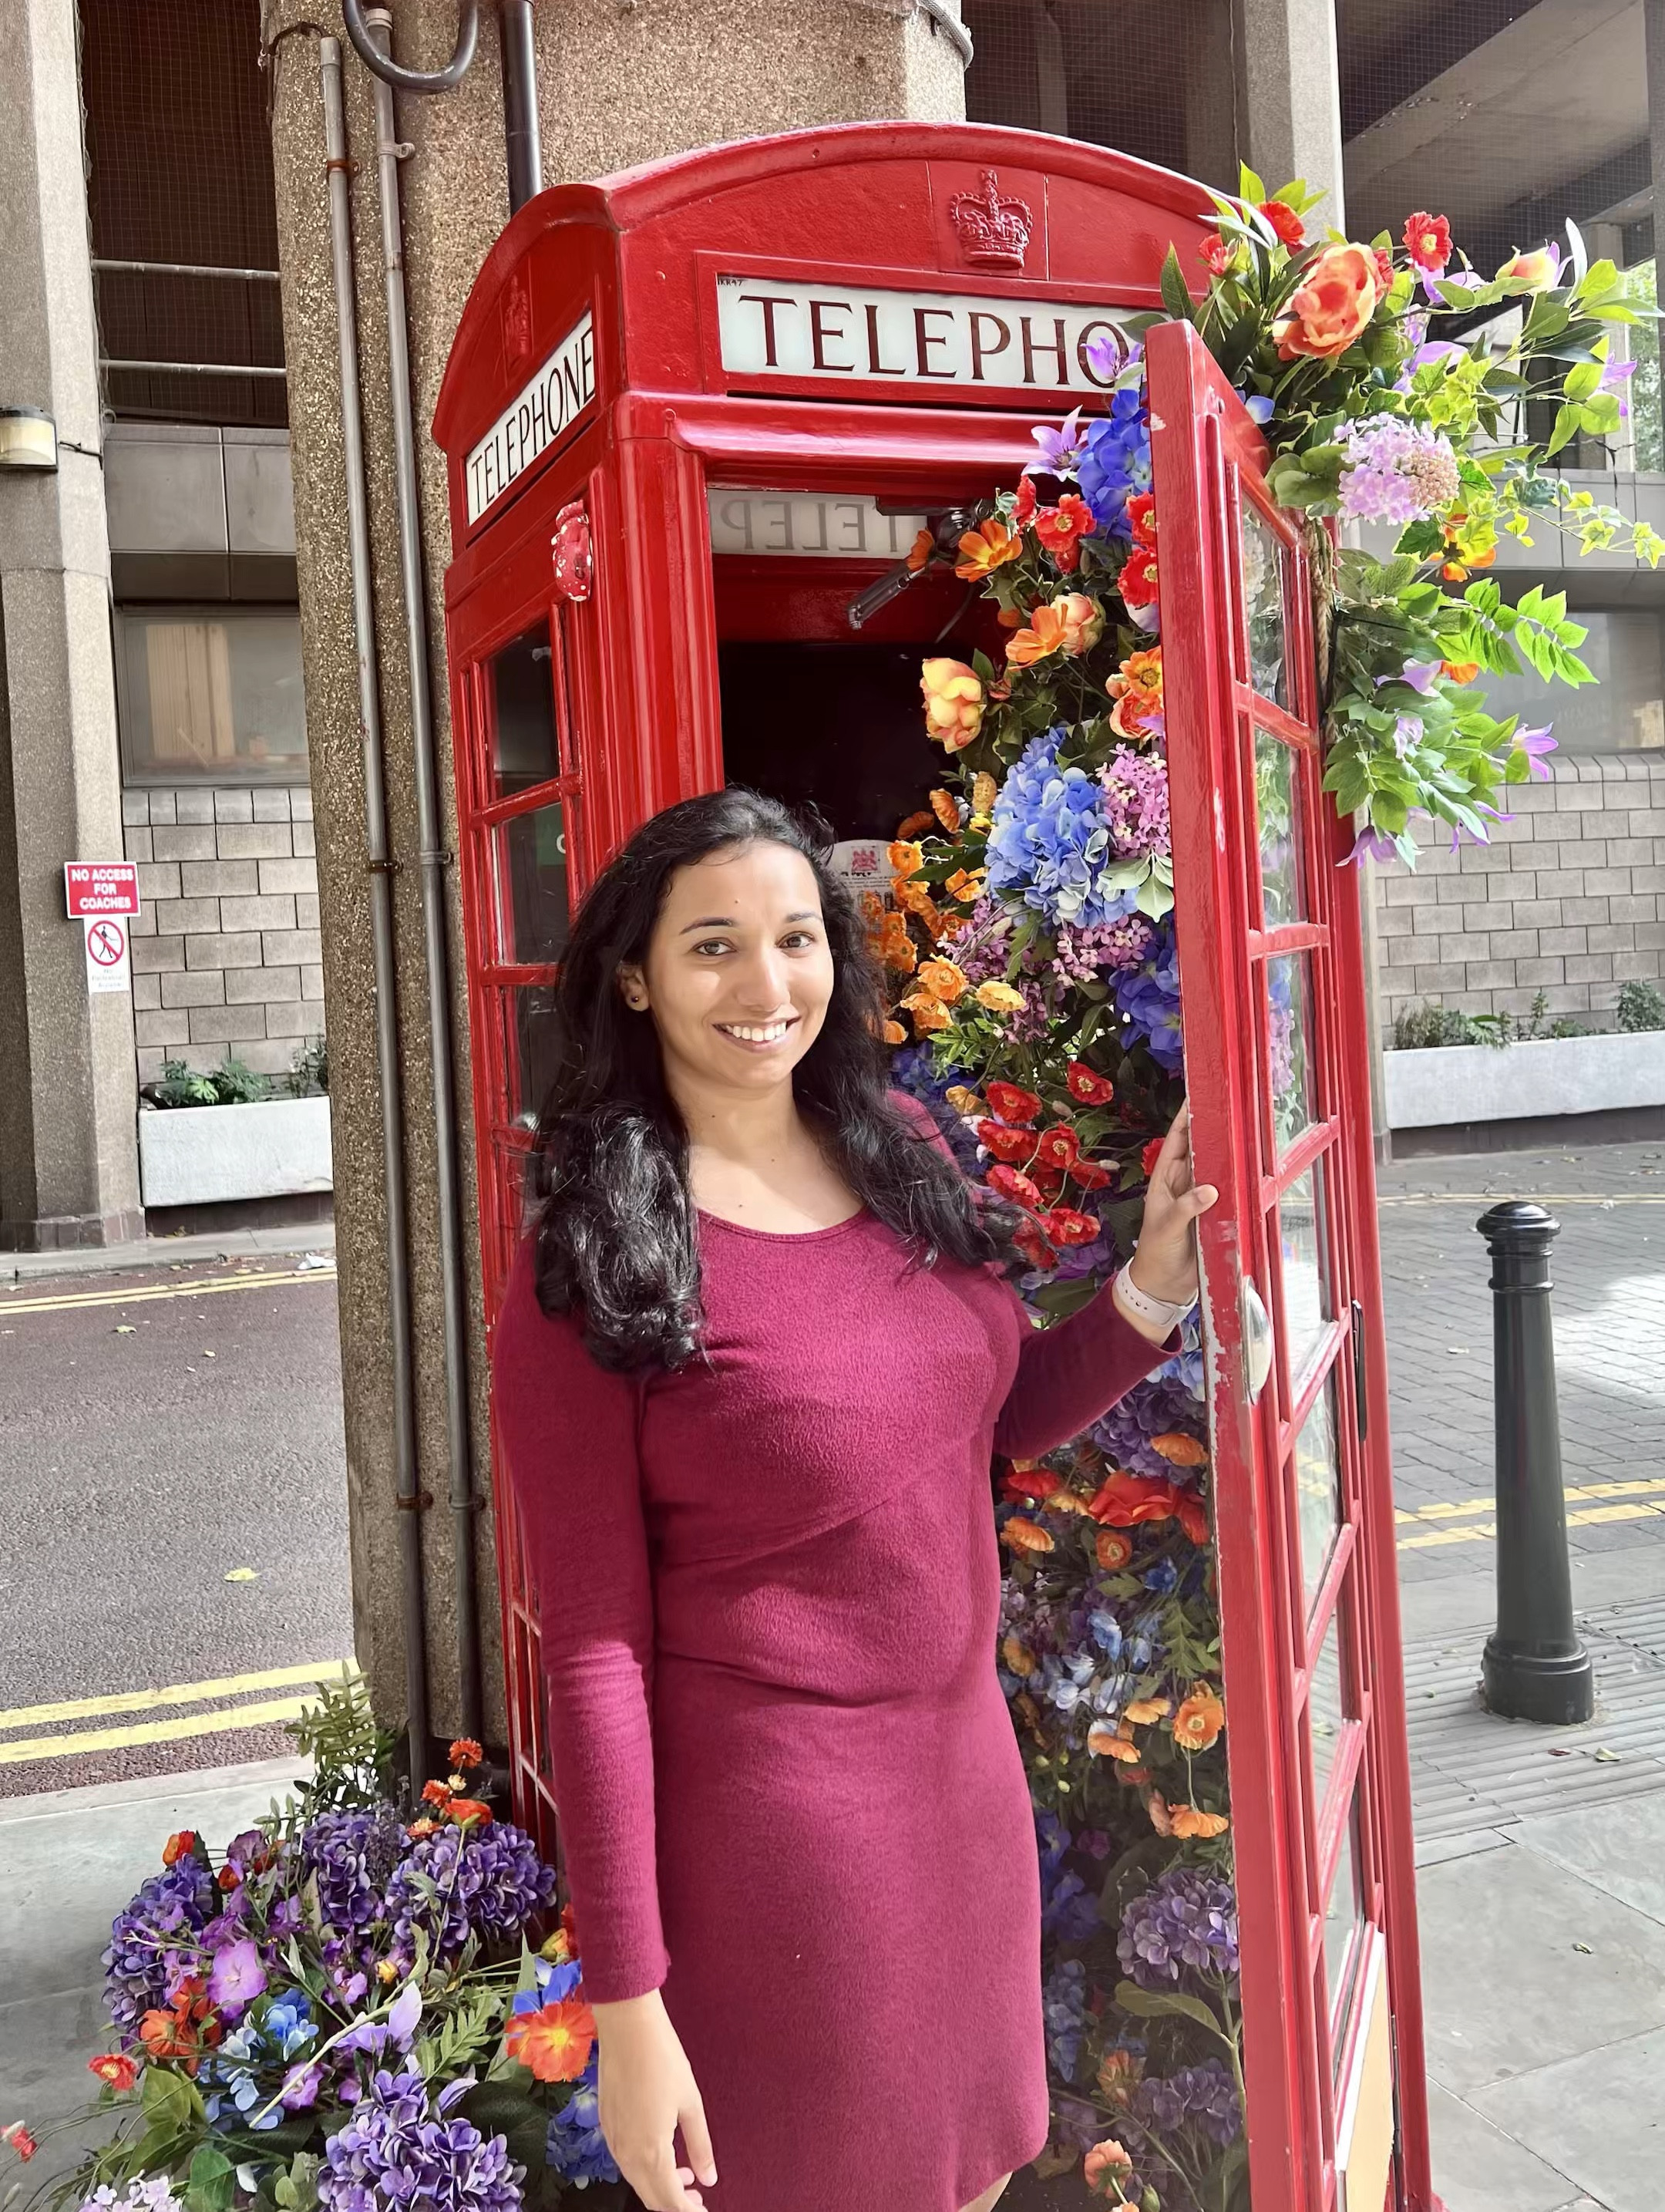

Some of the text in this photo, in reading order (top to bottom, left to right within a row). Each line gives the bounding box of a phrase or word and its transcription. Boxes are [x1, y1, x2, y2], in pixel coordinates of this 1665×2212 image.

[471, 326, 596, 514] TELEPHONE
[71, 868, 134, 882] NO ACCESS
[93, 882, 117, 895] FOR
[79, 896, 132, 910] COACHES
